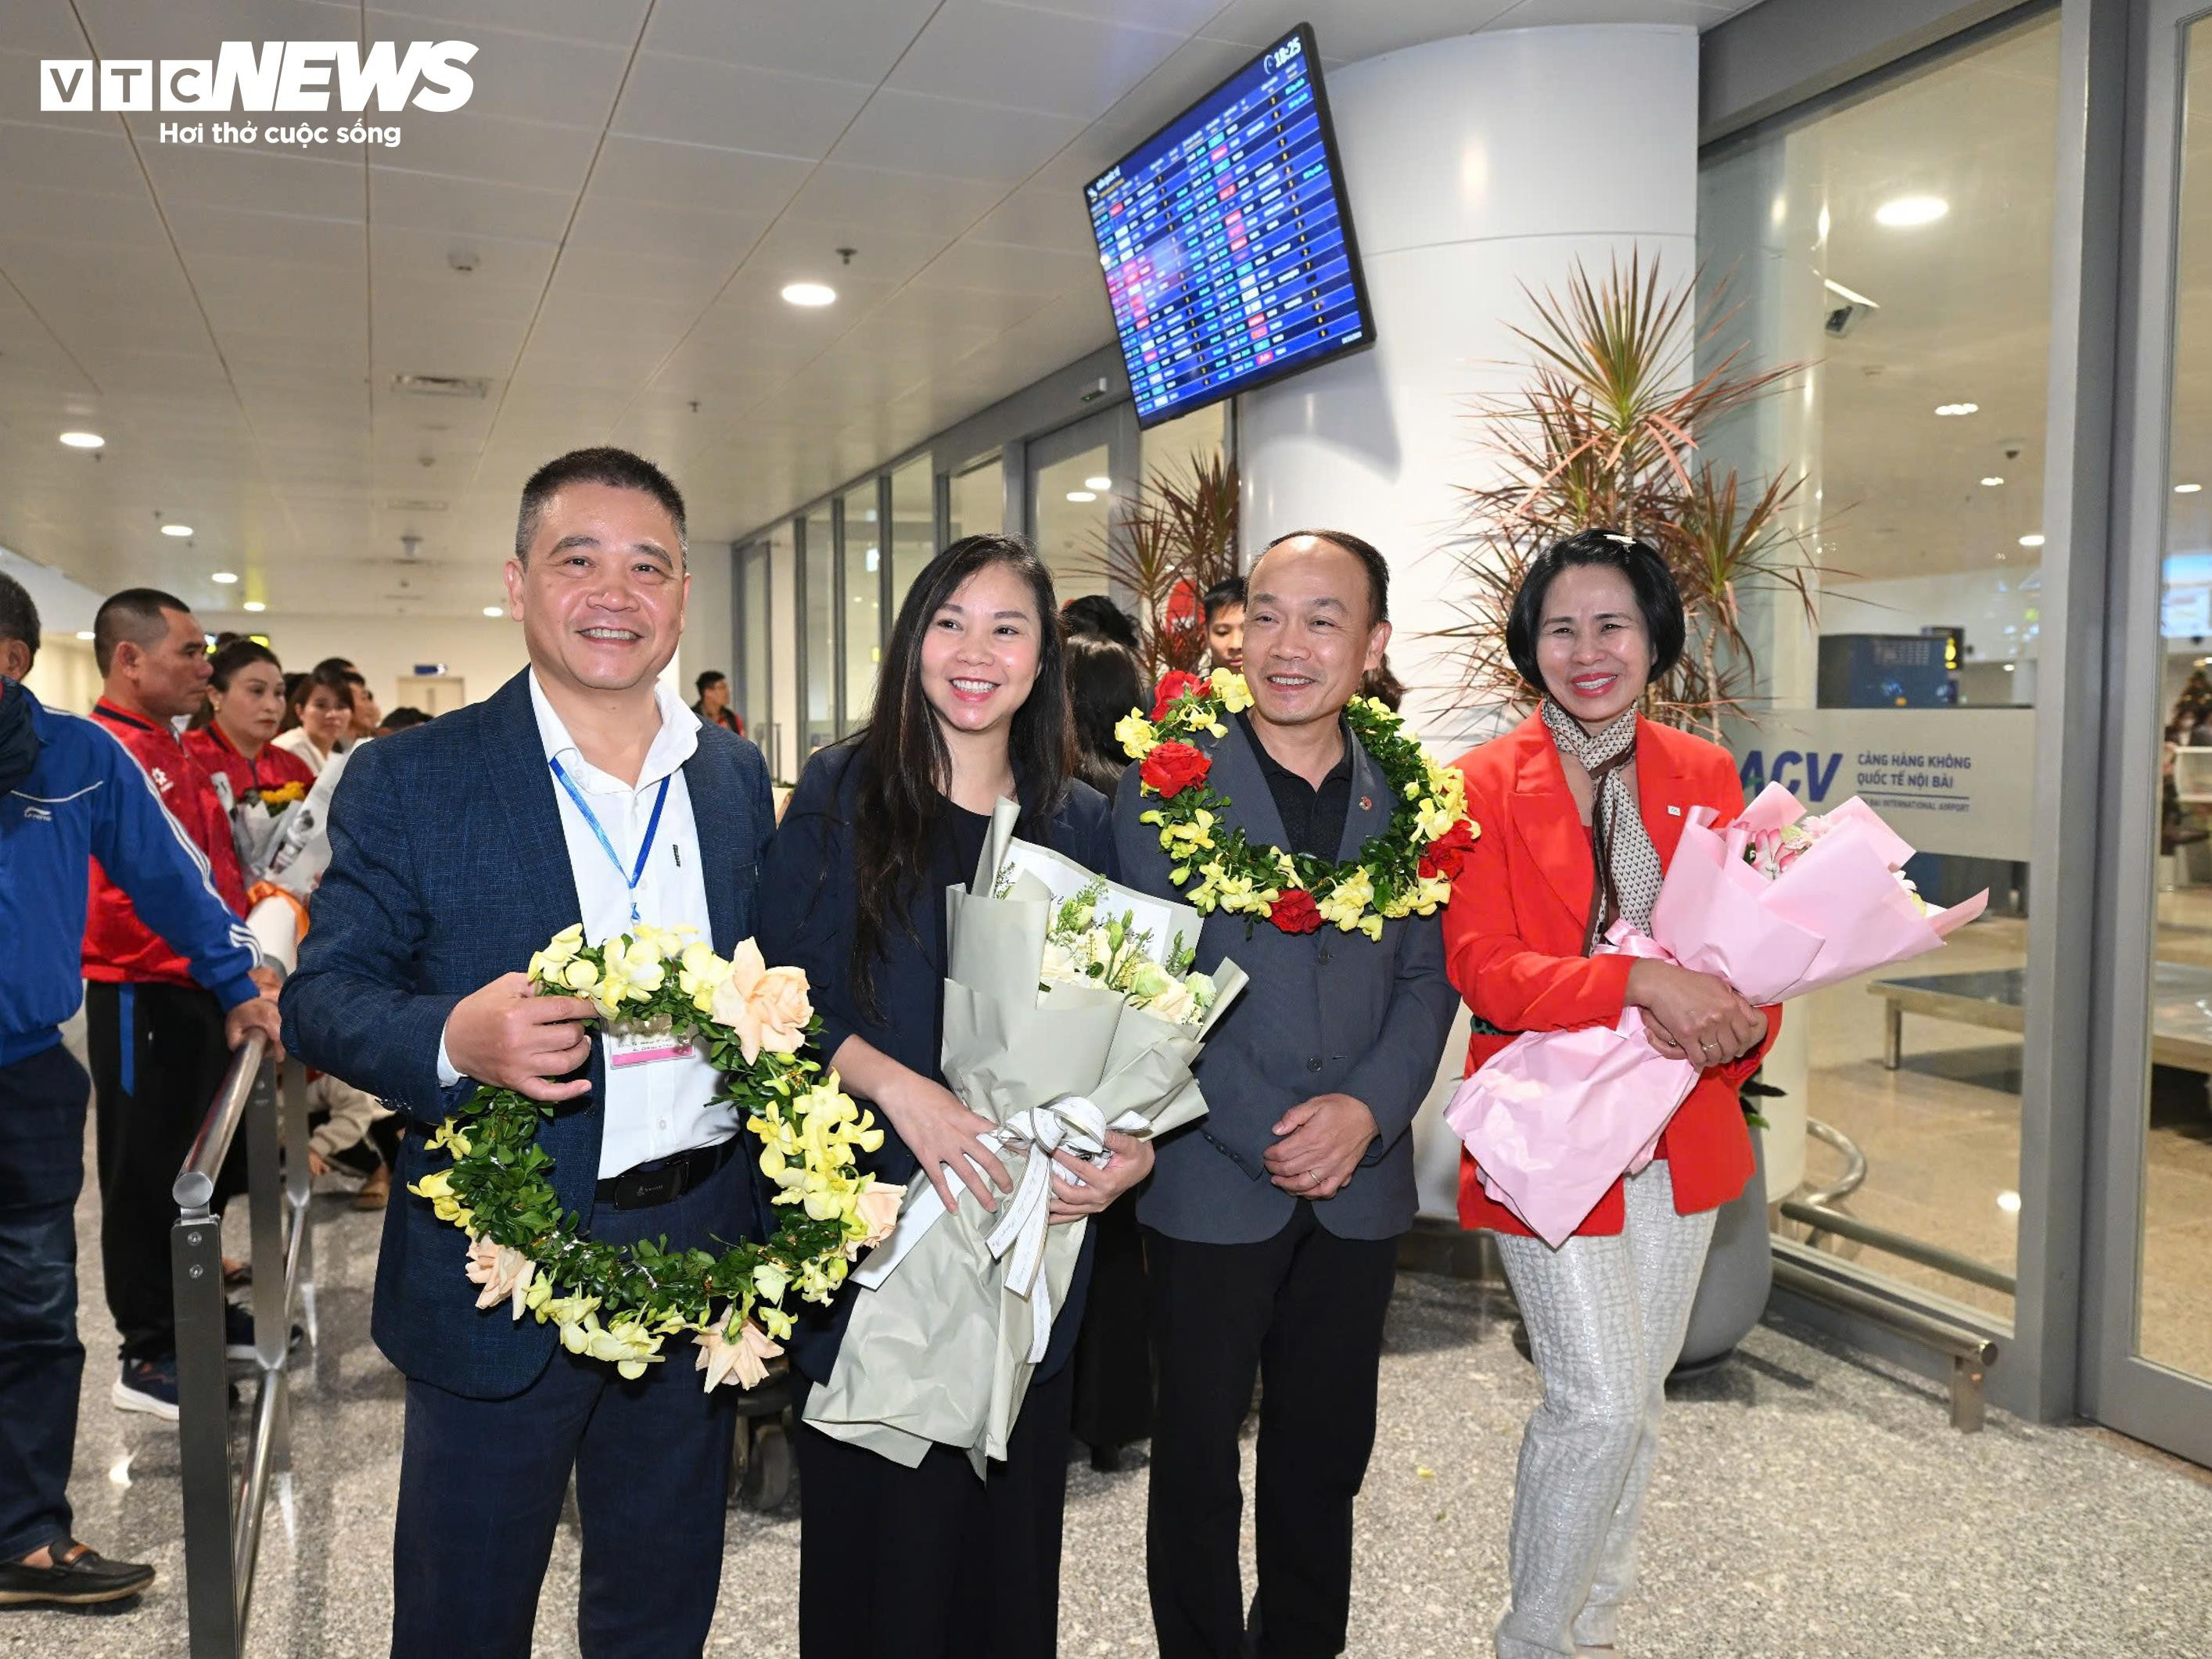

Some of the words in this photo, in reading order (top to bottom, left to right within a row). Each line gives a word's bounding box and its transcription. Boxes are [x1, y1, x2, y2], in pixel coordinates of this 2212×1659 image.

[1858, 750, 1888, 766] CẢNG
[1891, 751, 1924, 767] HÀNG
[1928, 752, 1971, 769] KHÔNG
[1740, 750, 1844, 803] ACV
[1857, 770, 1887, 786] QUỐC
[1891, 770, 1905, 786] TẾ
[1908, 774, 1928, 791] NỘI
[1932, 773, 1953, 788] BÀI
